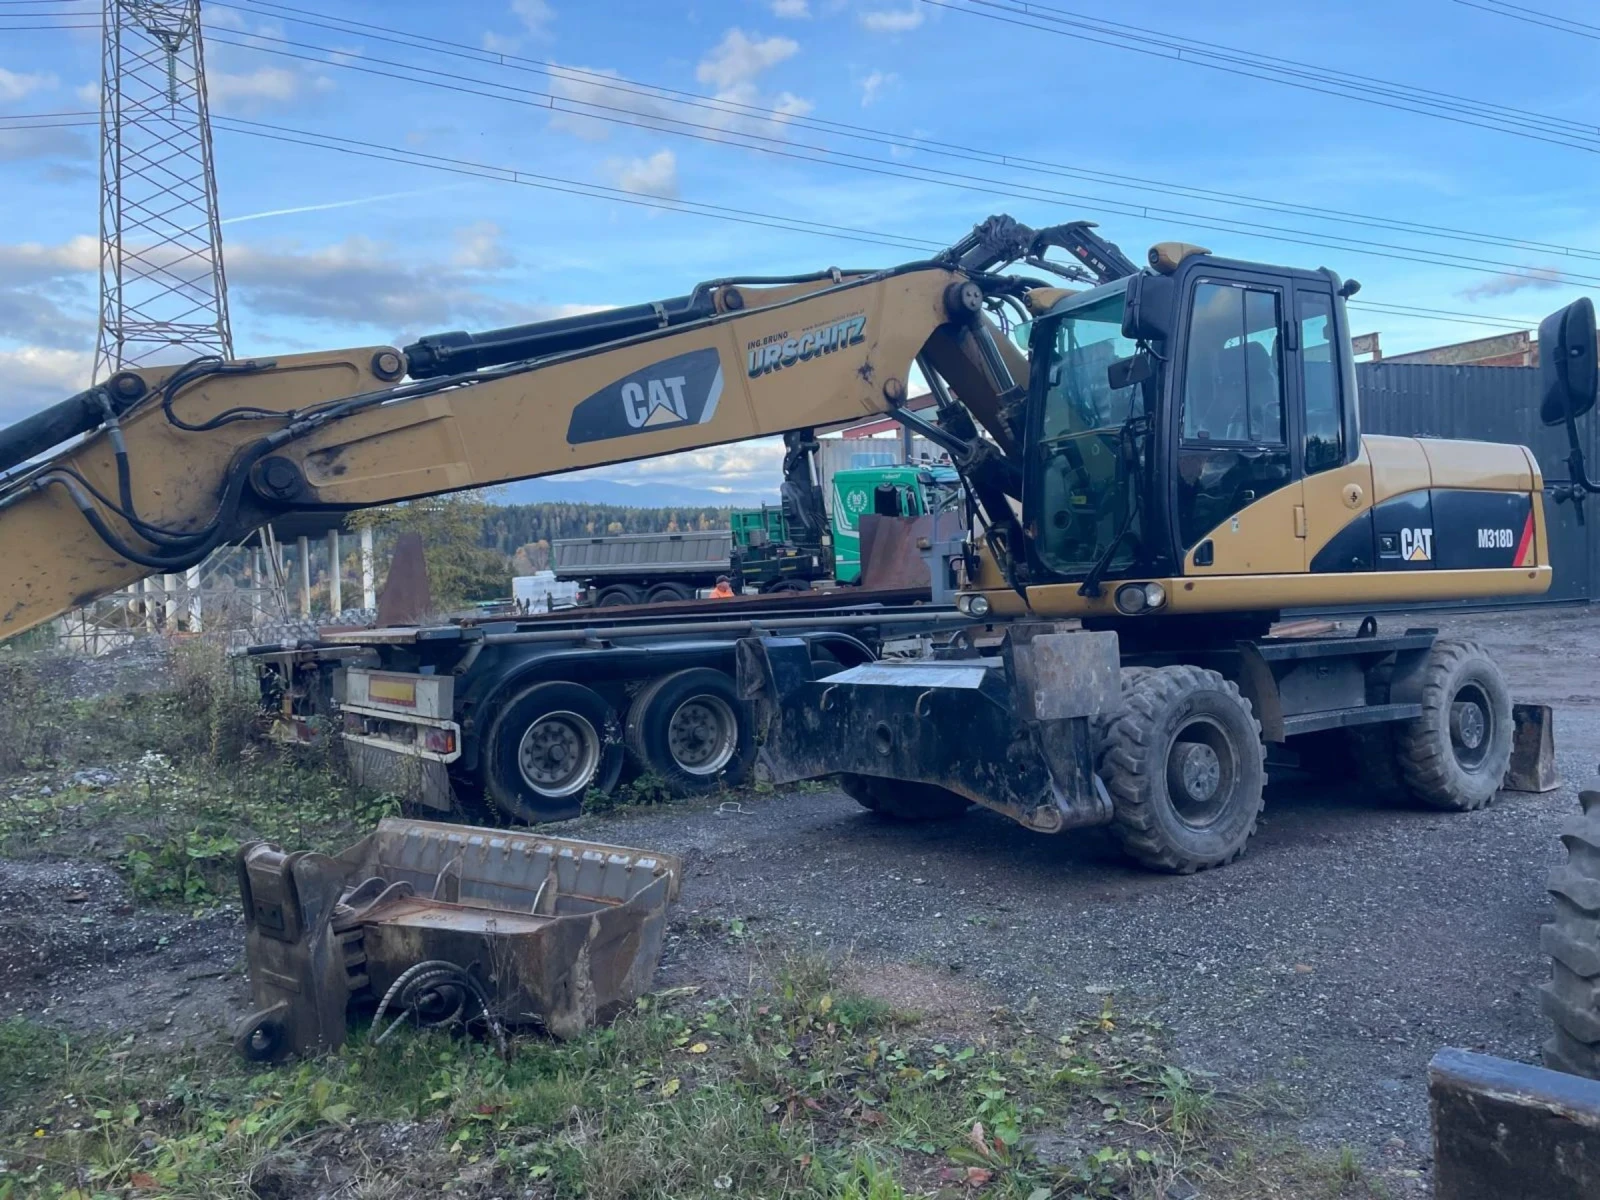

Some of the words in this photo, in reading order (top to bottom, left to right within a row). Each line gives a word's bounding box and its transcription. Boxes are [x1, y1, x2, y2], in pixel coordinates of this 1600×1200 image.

[748, 316, 867, 379] URSCHITZ
[763, 331, 789, 344] BRUNO
[621, 376, 688, 429] CAT
[1401, 528, 1433, 560] CAT
[1477, 529, 1514, 549] M318D
